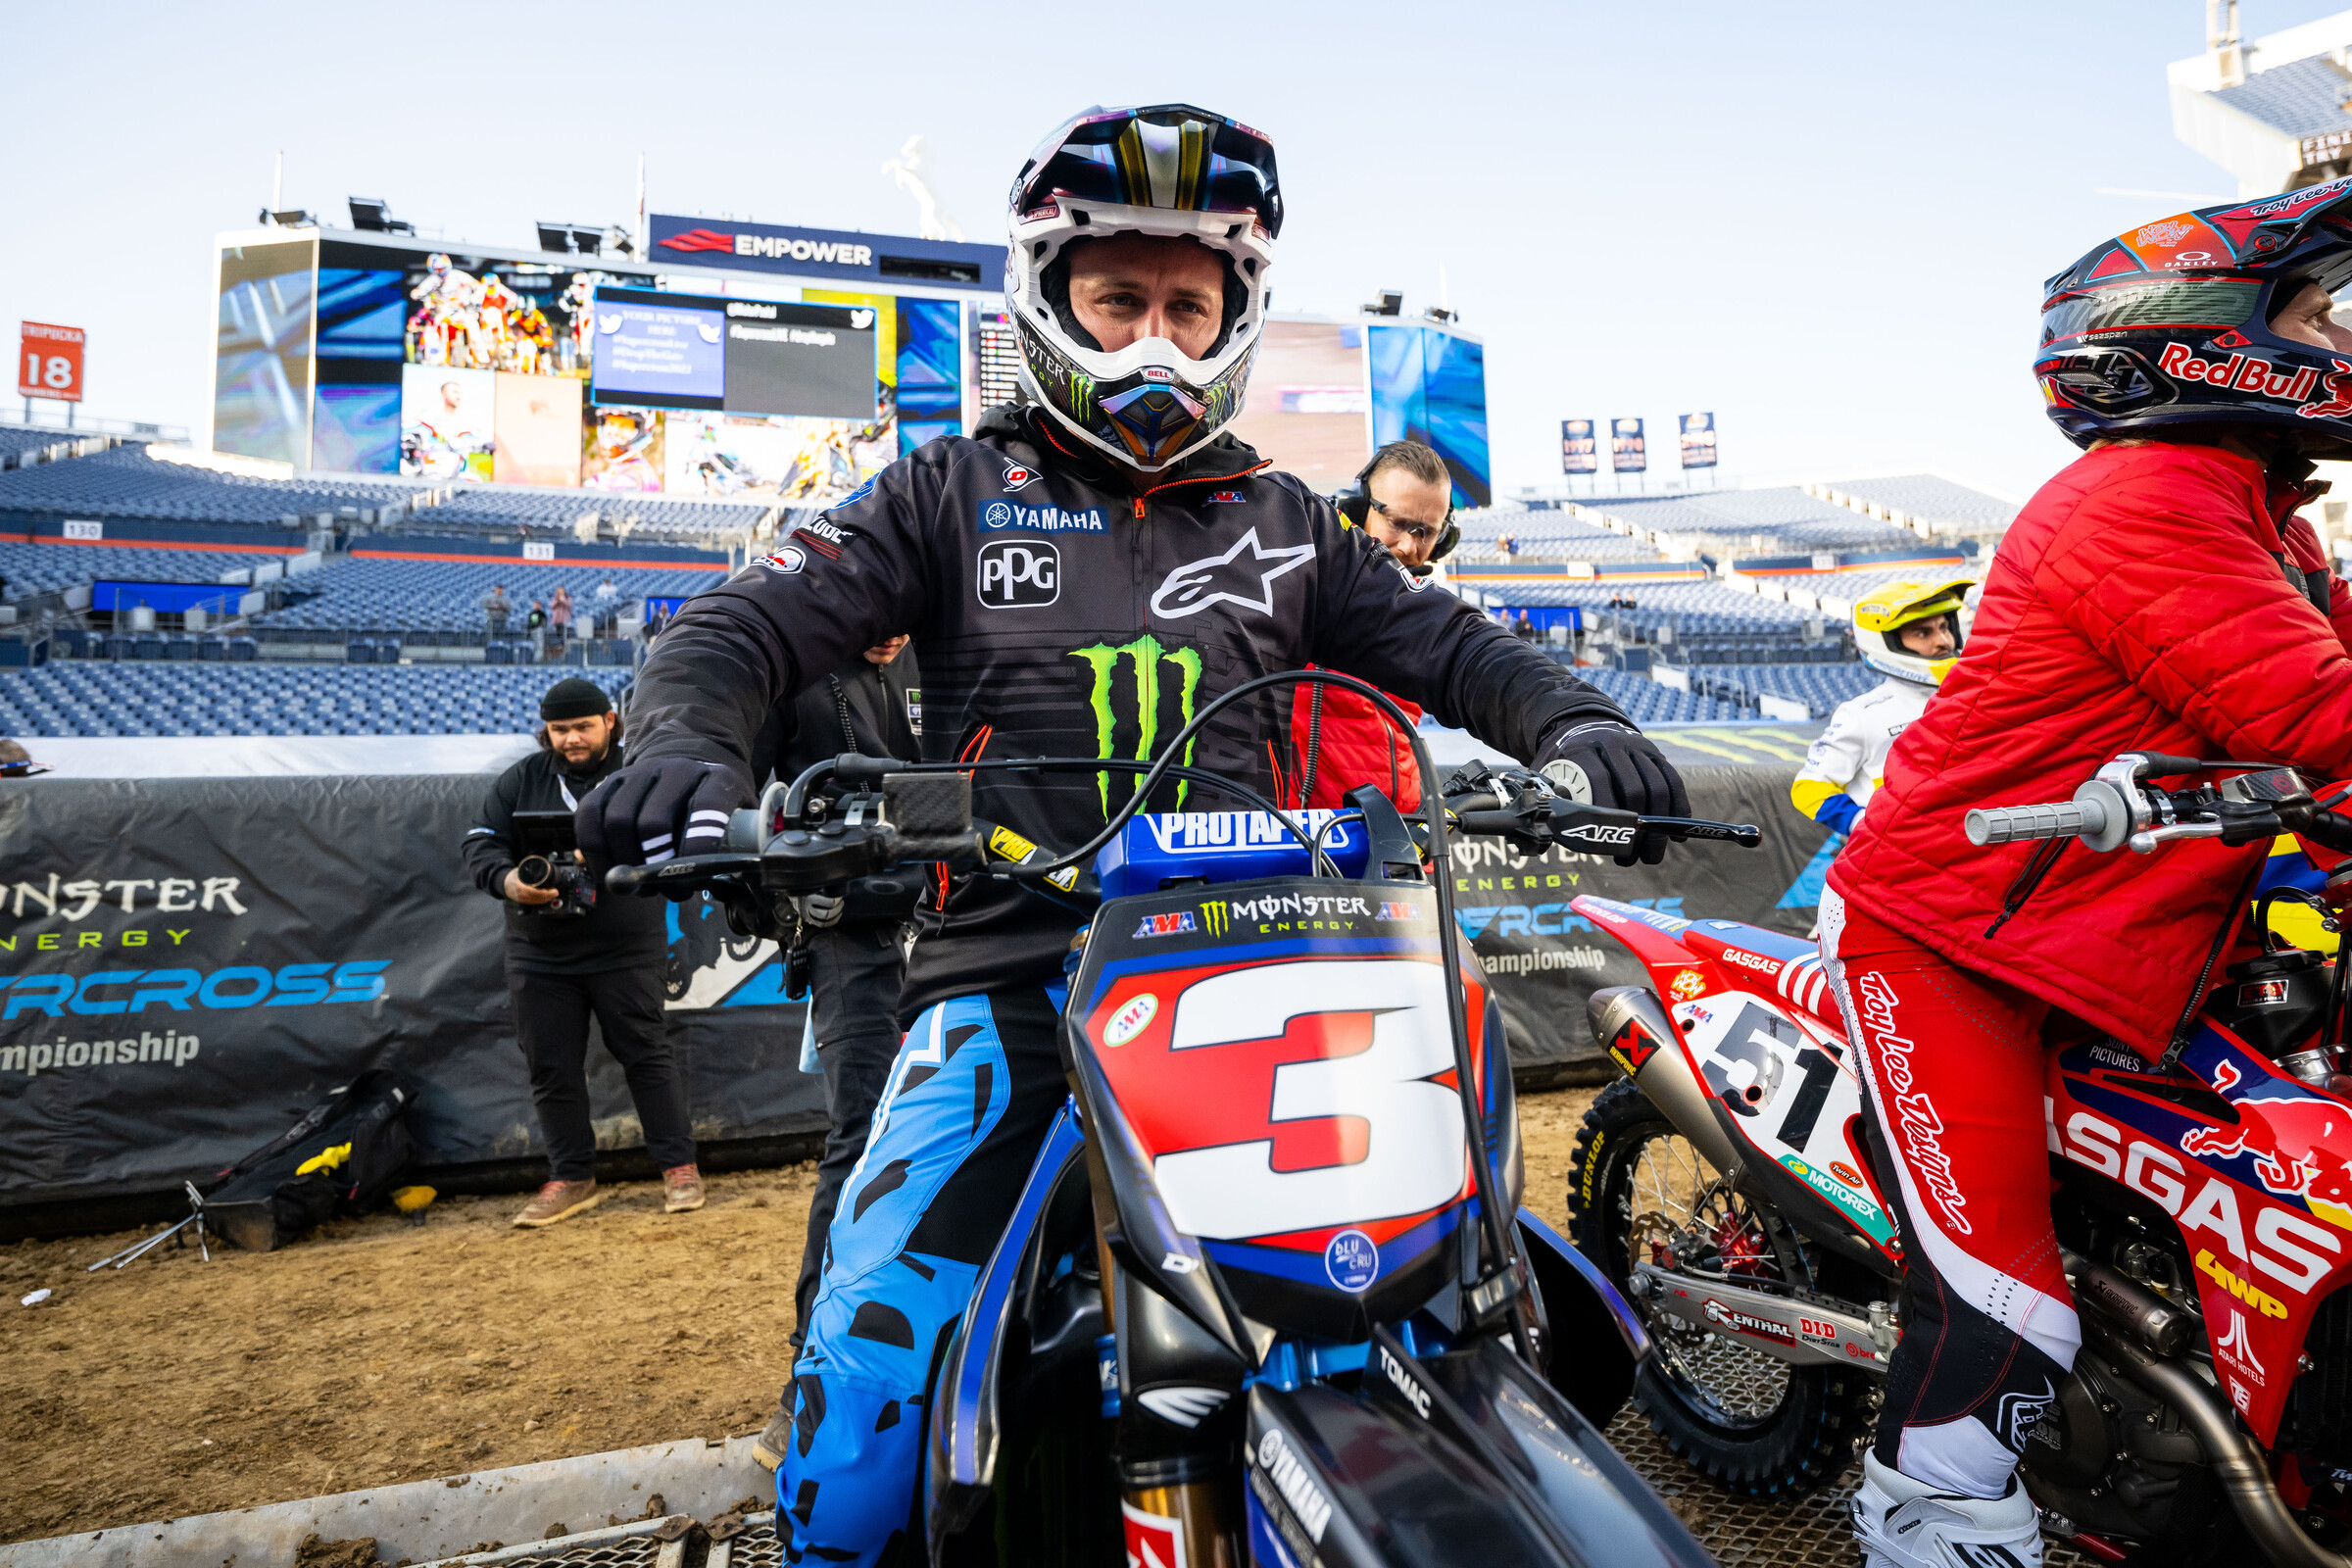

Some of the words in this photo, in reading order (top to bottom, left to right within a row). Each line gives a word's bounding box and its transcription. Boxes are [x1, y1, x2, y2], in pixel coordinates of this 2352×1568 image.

[2250, 199, 2290, 216] Troy
[2293, 187, 2328, 203] Lee
[734, 233, 872, 267] EMPOWER
[2088, 329, 2128, 341] seaspan
[27, 353, 73, 389] 18
[1147, 369, 1169, 379] BELL
[2158, 342, 2244, 389] Red
[2232, 358, 2322, 402] Bull
[70, 523, 99, 537] 130
[1013, 505, 1102, 530] YAMAHA
[1561, 823, 1636, 844] ARC
[0, 872, 248, 921] NSTER
[1455, 873, 1580, 892] ENERGY
[1231, 892, 1371, 922] MONSTER
[1374, 901, 1424, 921] AMA
[1577, 903, 1628, 924] DUNLOP
[1132, 910, 1199, 940] AMA
[1259, 921, 1354, 934] ENERGY
[1722, 948, 1782, 974] GASGAS
[0, 959, 393, 1020] RCROSS
[1860, 970, 1899, 1034] Troy
[1118, 1001, 1150, 1039] AMA
[1684, 1004, 1713, 1023] AMA
[1876, 1033, 1914, 1094] Lee
[2089, 1045, 2140, 1072] PICTURES
[1701, 1001, 1844, 1154] 51
[1152, 958, 1467, 1241] 3
[1583, 1130, 1605, 1202] DUNLOP
[1832, 1163, 1850, 1179] Twin
[1848, 1175, 1862, 1186] Air
[1895, 1093, 1973, 1236] Designs
[1808, 1169, 1878, 1221] MOTOREX
[2043, 1095, 2342, 1296] SGAS
[1348, 1252, 1372, 1270] CRU
[2195, 1248, 2288, 1320] 4WP
[1703, 1298, 1795, 1339] RENTHAL
[1859, 1347, 1876, 1360] bre
[2218, 1348, 2236, 1371] ATARI
[2237, 1361, 2265, 1387] HOTELS
[1379, 1345, 1432, 1420] TOMAC
[1271, 1444, 1333, 1545] YAMAHA
